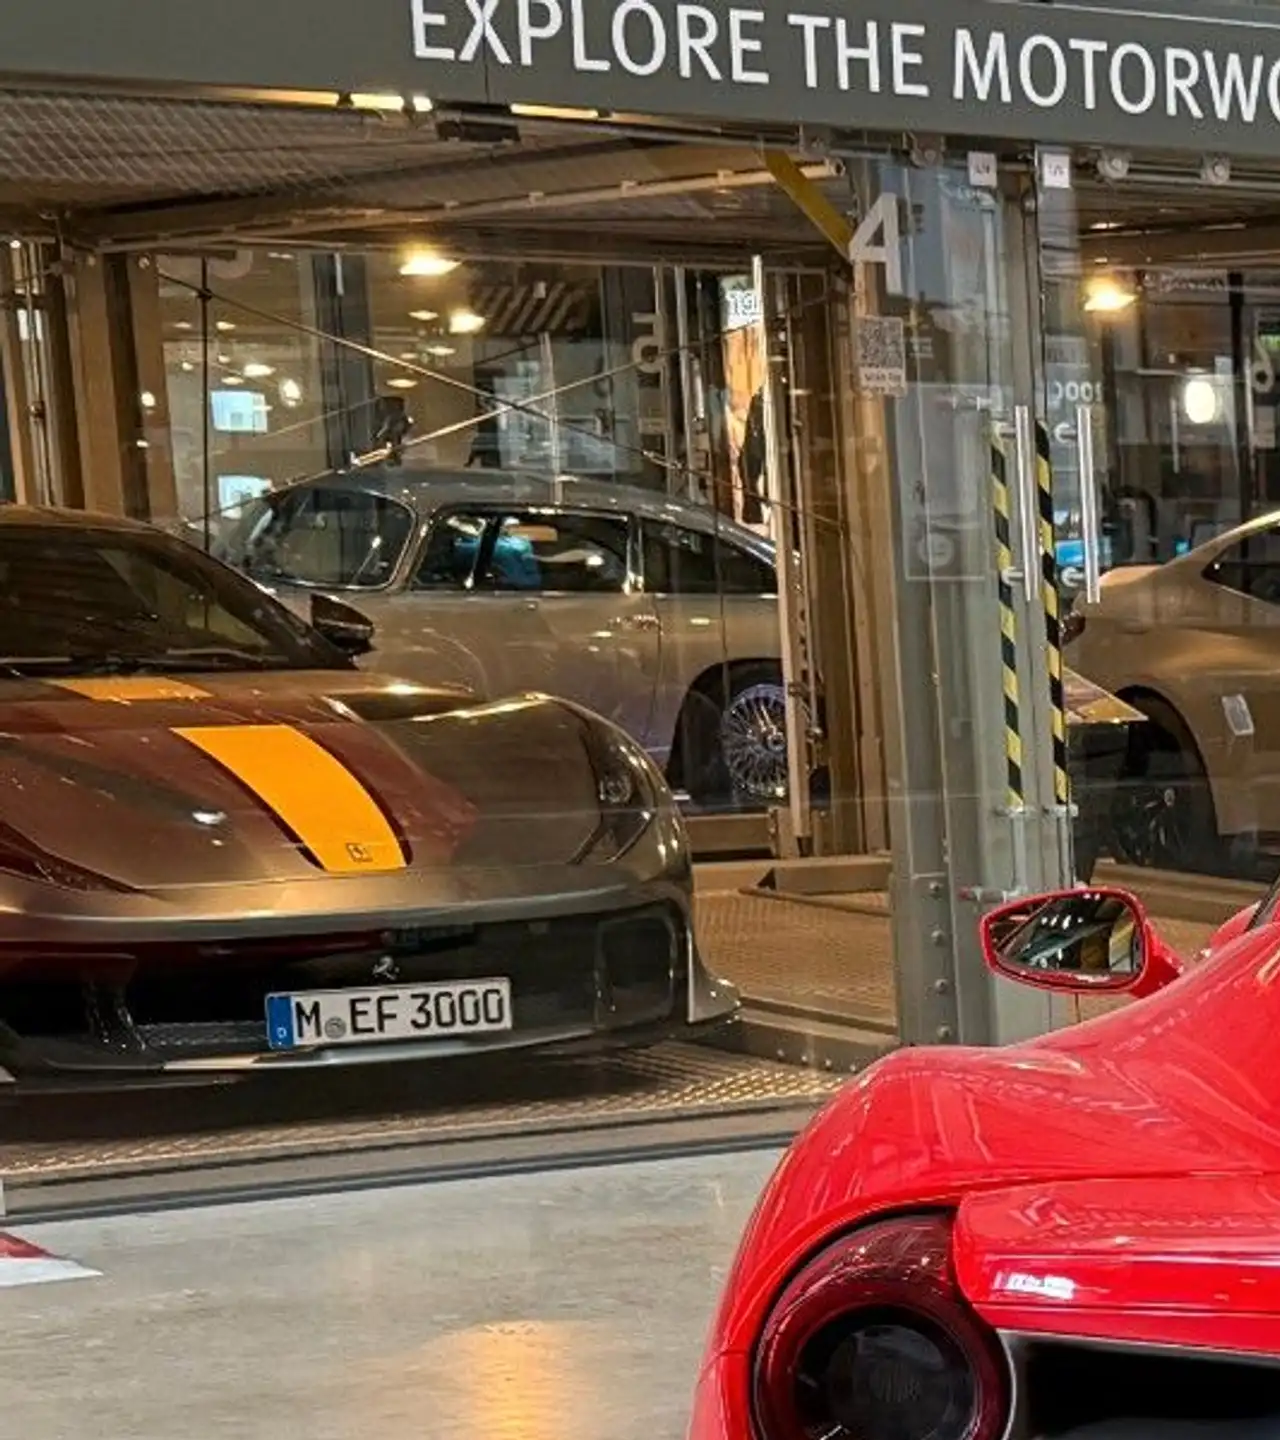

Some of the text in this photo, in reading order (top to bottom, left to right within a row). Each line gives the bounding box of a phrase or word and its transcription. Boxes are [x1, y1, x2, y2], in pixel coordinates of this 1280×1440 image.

[411, 0, 770, 85] EXPLORE
[788, 14, 931, 97] THE
[849, 191, 904, 300] 4
[295, 988, 504, 1039] M EF 3000
